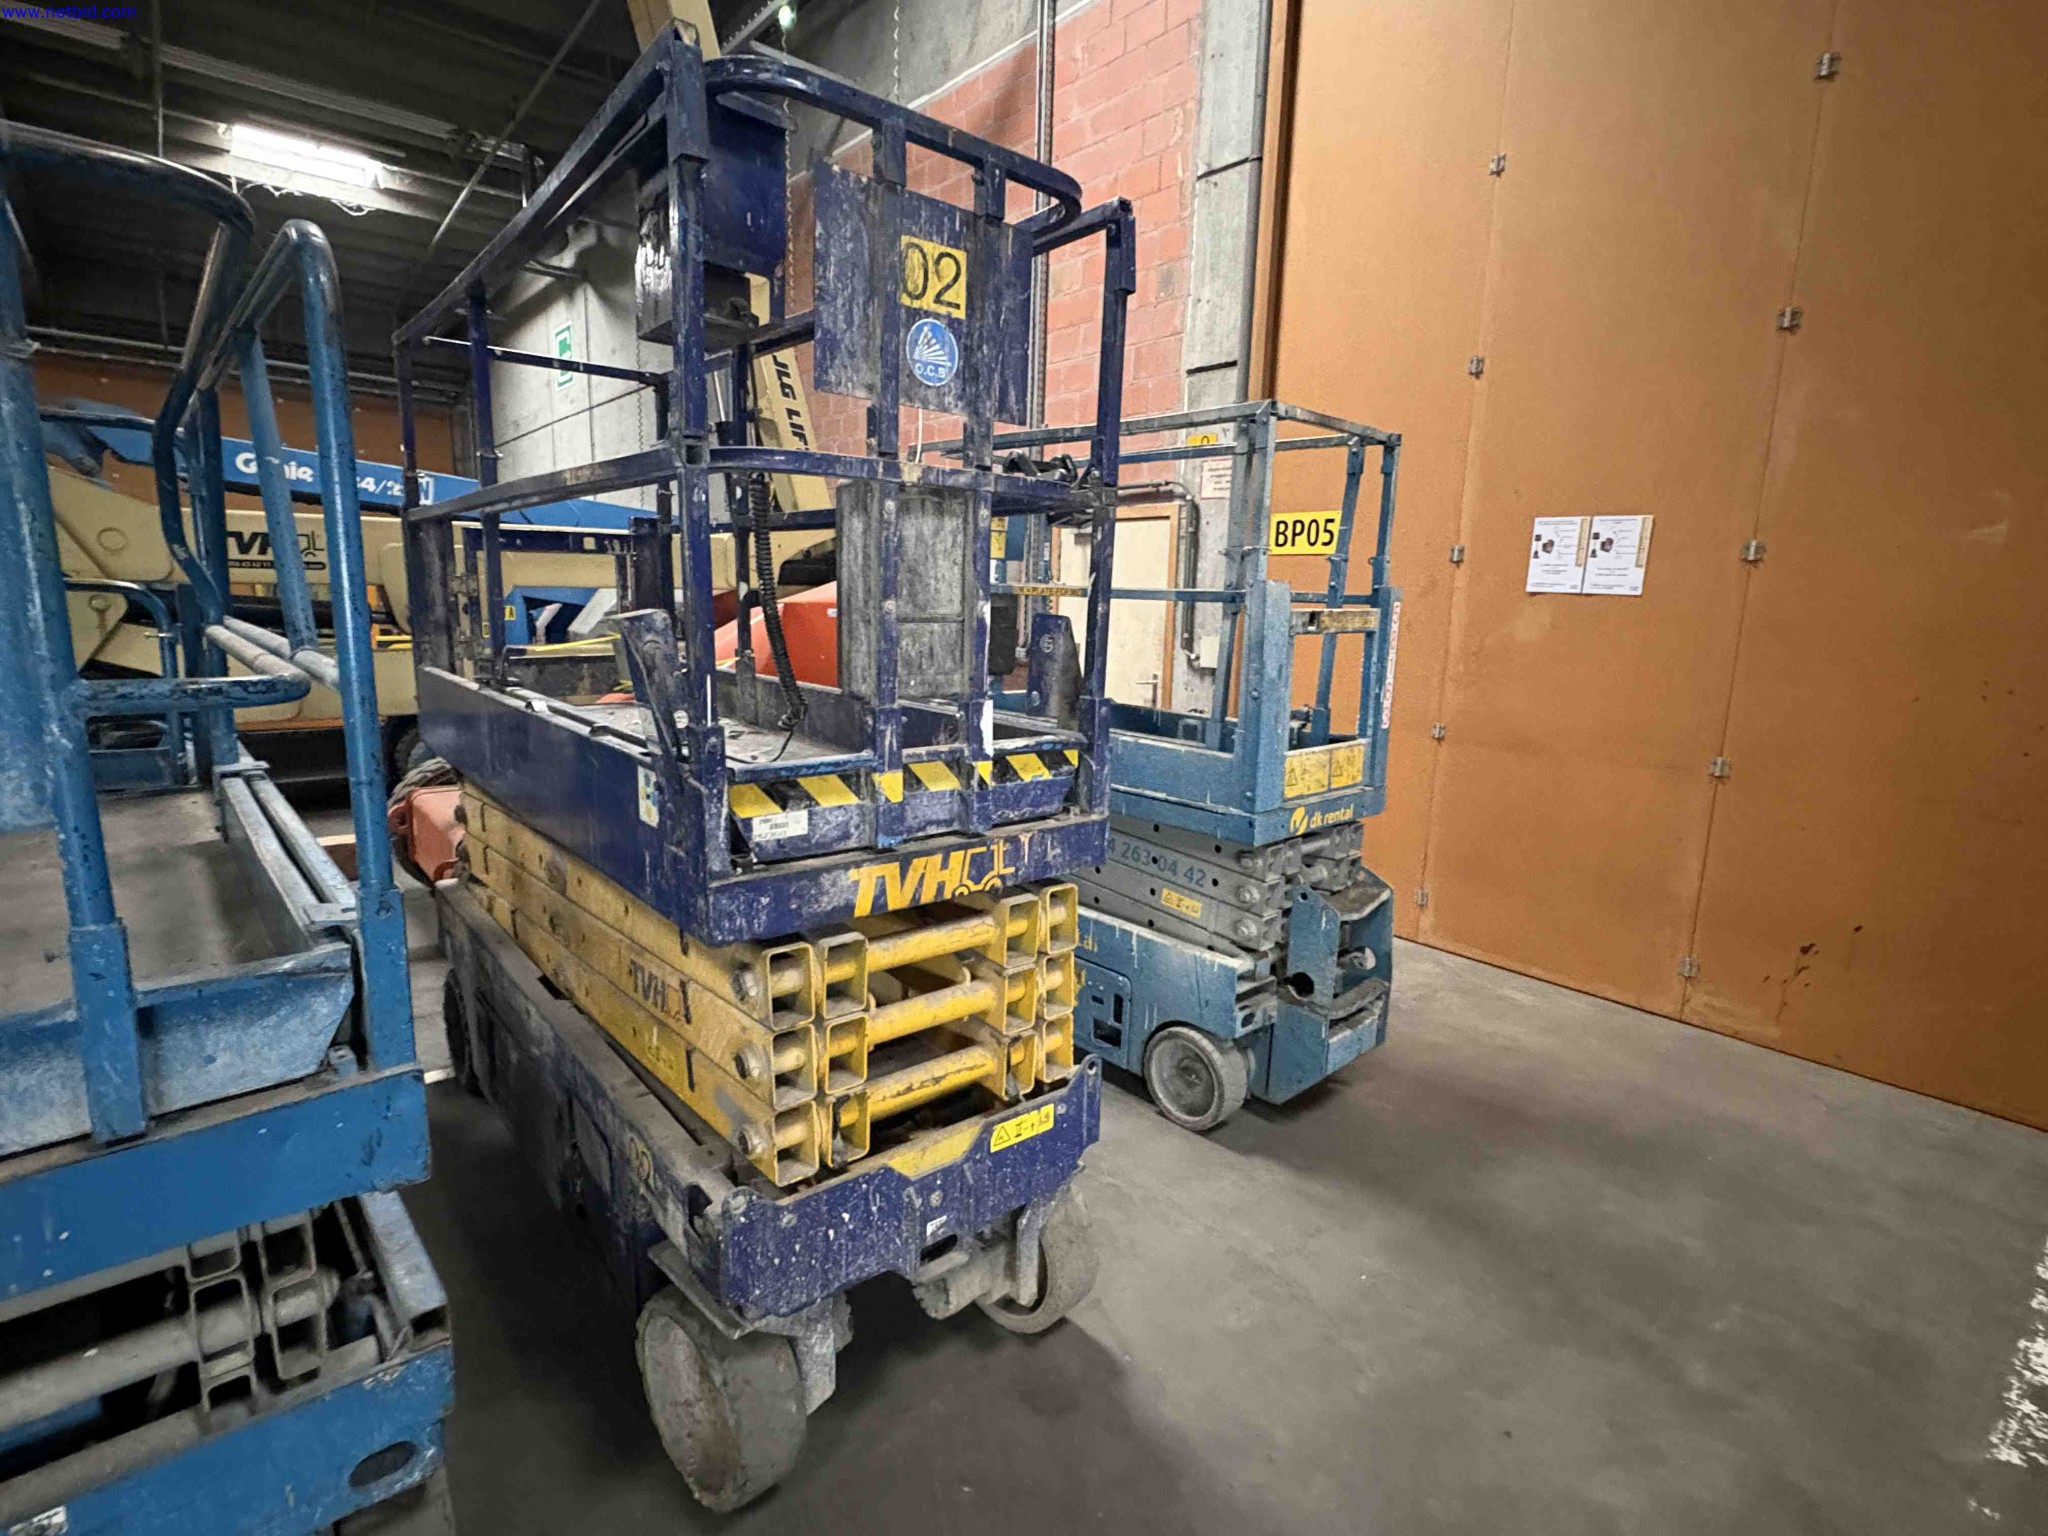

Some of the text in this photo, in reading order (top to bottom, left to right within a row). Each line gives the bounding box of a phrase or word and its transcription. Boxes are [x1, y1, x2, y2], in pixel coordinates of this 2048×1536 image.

[902, 241, 962, 310] 02
[771, 352, 810, 451] JLG LIF
[1274, 518, 1335, 548] BP05
[1310, 802, 1354, 829] dk rental
[848, 849, 967, 919] TVH
[1121, 841, 1151, 867] 263
[1156, 855, 1179, 877] 04
[1183, 865, 1207, 888] 42
[628, 958, 667, 1014] TVH
